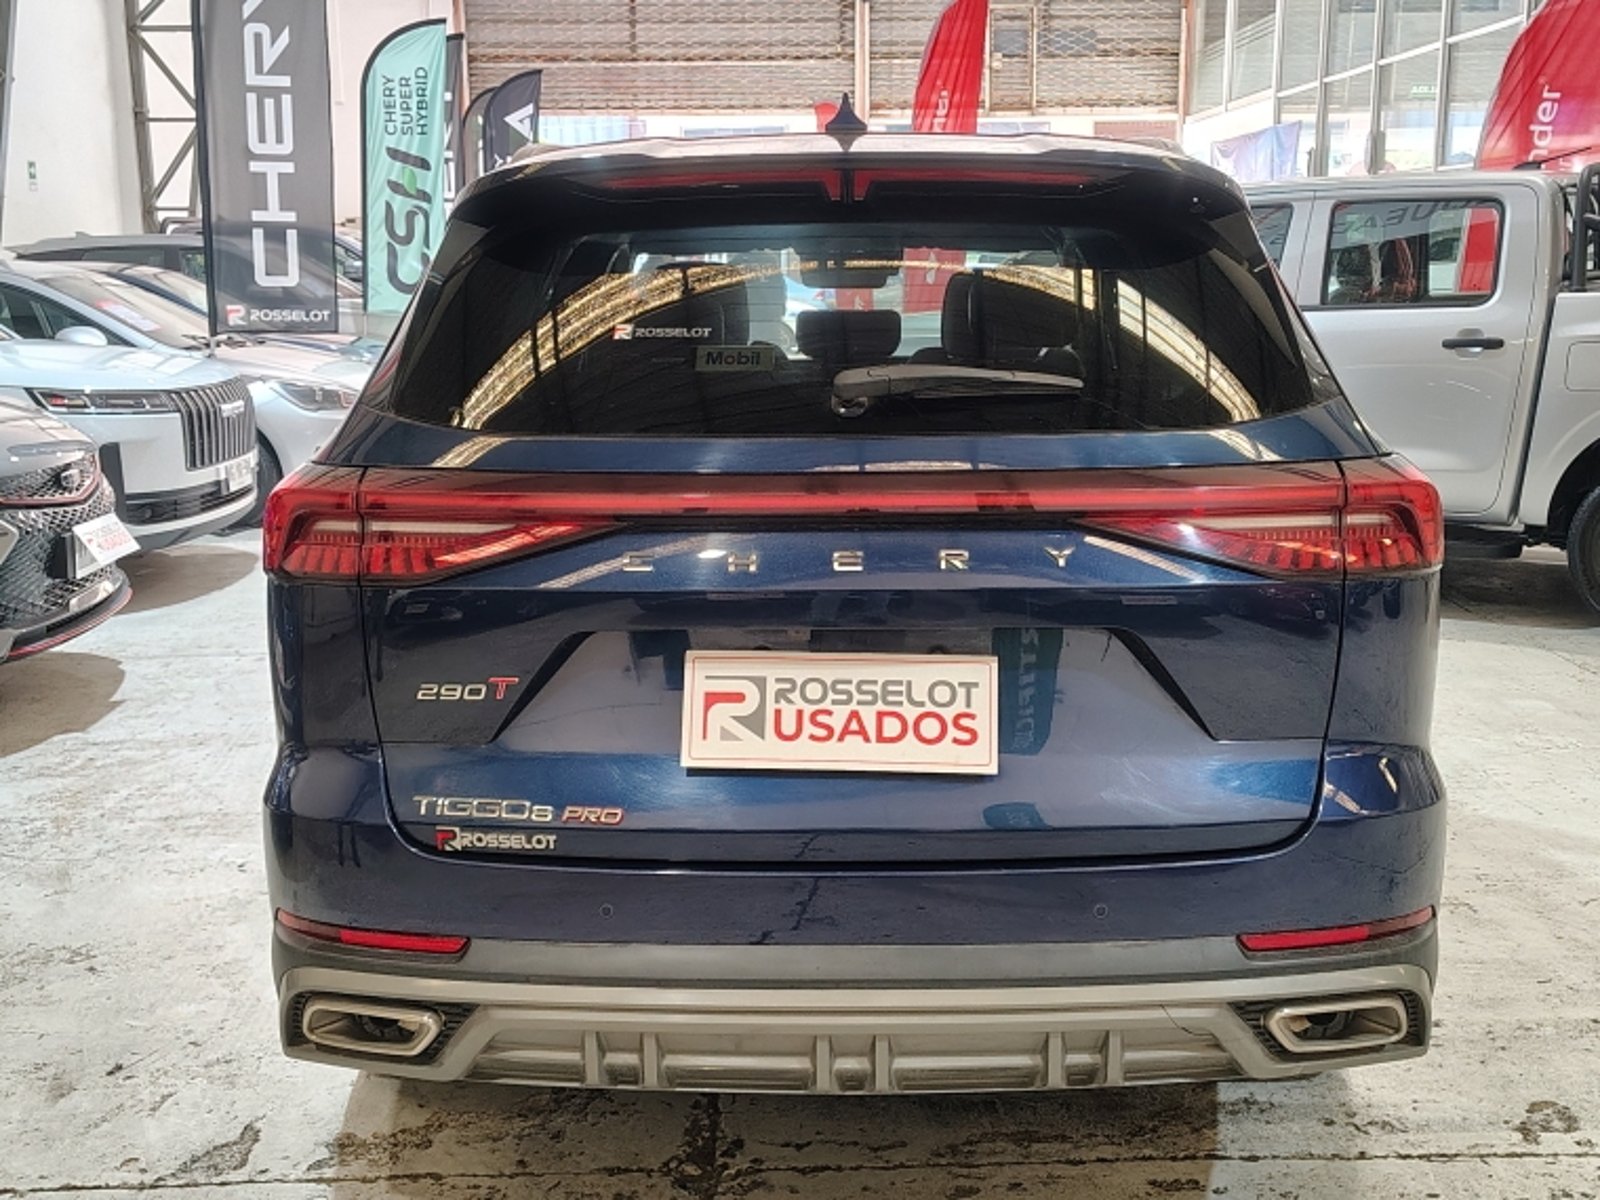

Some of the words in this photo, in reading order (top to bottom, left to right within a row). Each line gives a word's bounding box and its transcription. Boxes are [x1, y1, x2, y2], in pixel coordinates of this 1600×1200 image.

[383, 74, 398, 136] CHERY
[400, 75, 414, 136] SUPER
[415, 66, 429, 136] HYBRID
[250, 309, 331, 321] ROSSELOT
[635, 327, 712, 338] ROSSELOT
[706, 351, 761, 365] Mobil
[622, 546, 1076, 573] CHERY
[774, 677, 979, 708] ROSSELOT
[774, 709, 979, 746] USADOS
[561, 806, 624, 825] PRO
[461, 832, 557, 850] ROSSELOT
